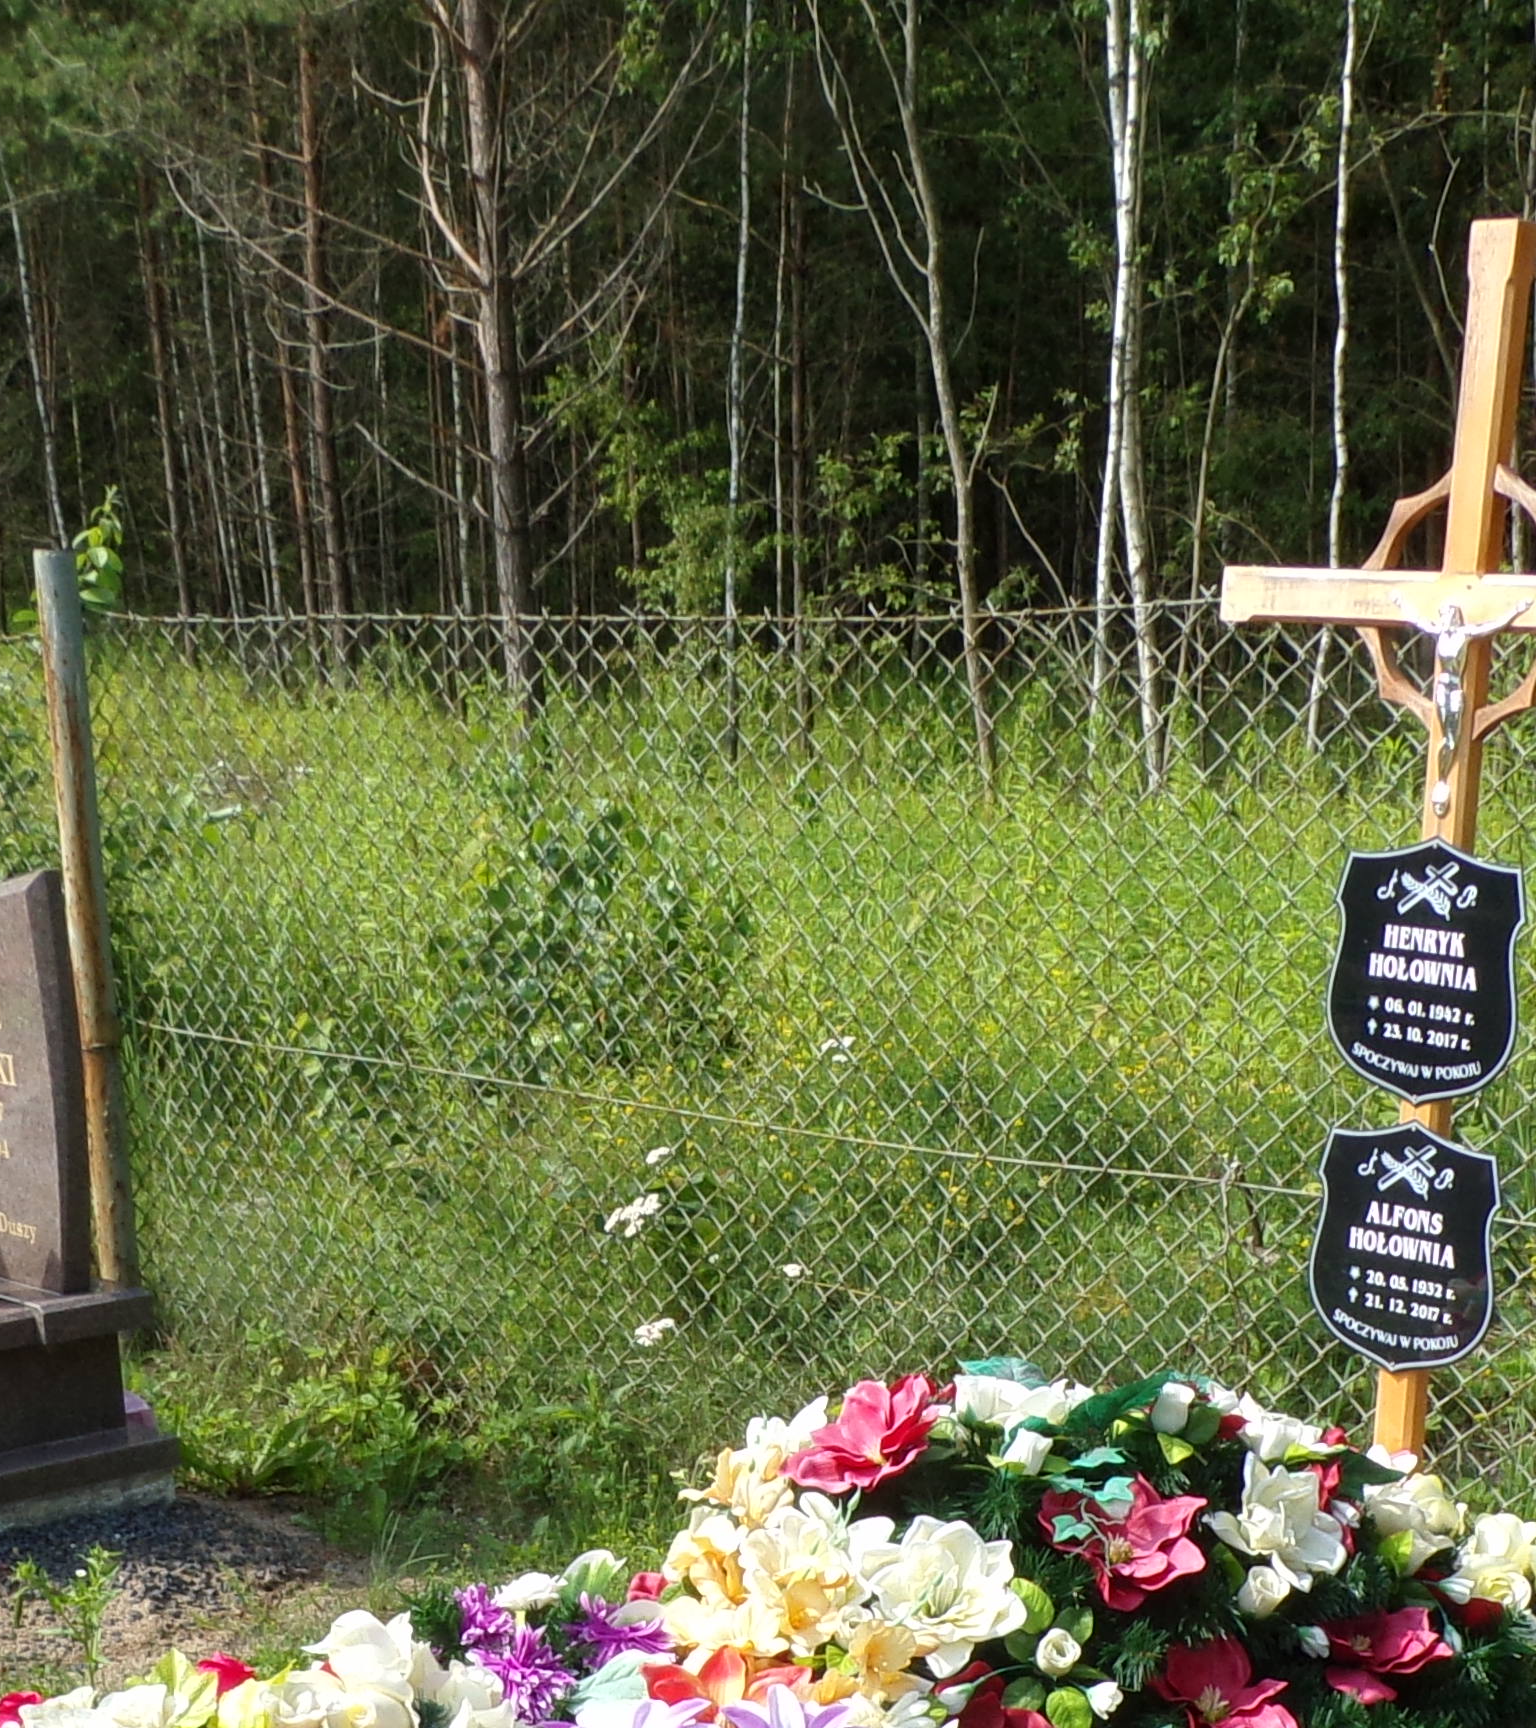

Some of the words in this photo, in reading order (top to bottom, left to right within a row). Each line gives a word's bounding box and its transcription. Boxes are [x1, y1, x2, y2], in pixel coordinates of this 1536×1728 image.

[1383, 923, 1466, 959] HENRYK
[1368, 952, 1478, 992] HOŁOWNIA
[1384, 997, 1405, 1014] 06.
[1407, 1000, 1426, 1018] 01.
[1428, 1003, 1462, 1023] 1942
[1383, 1022, 1402, 1040] 23.
[1406, 1026, 1424, 1043] 10.
[1426, 1030, 1459, 1050] 2017
[1351, 1041, 1419, 1079] SPOCZYWAJ
[1421, 1065, 1433, 1079] W
[1435, 1060, 1482, 1081] POKOJU
[1365, 1200, 1444, 1236] ALFONS
[1348, 1226, 1456, 1270] HOŁOWNIA
[1365, 1269, 1386, 1287] 20.
[1389, 1274, 1409, 1292] 05.
[1412, 1278, 1443, 1299] 1932
[1364, 1292, 1384, 1309] 21.
[1388, 1297, 1407, 1314] 12.
[1410, 1302, 1440, 1322] 2017
[1332, 1307, 1397, 1347] SPOCZYWAJ
[1399, 1335, 1412, 1349] W
[1413, 1334, 1459, 1351] POKOJU
